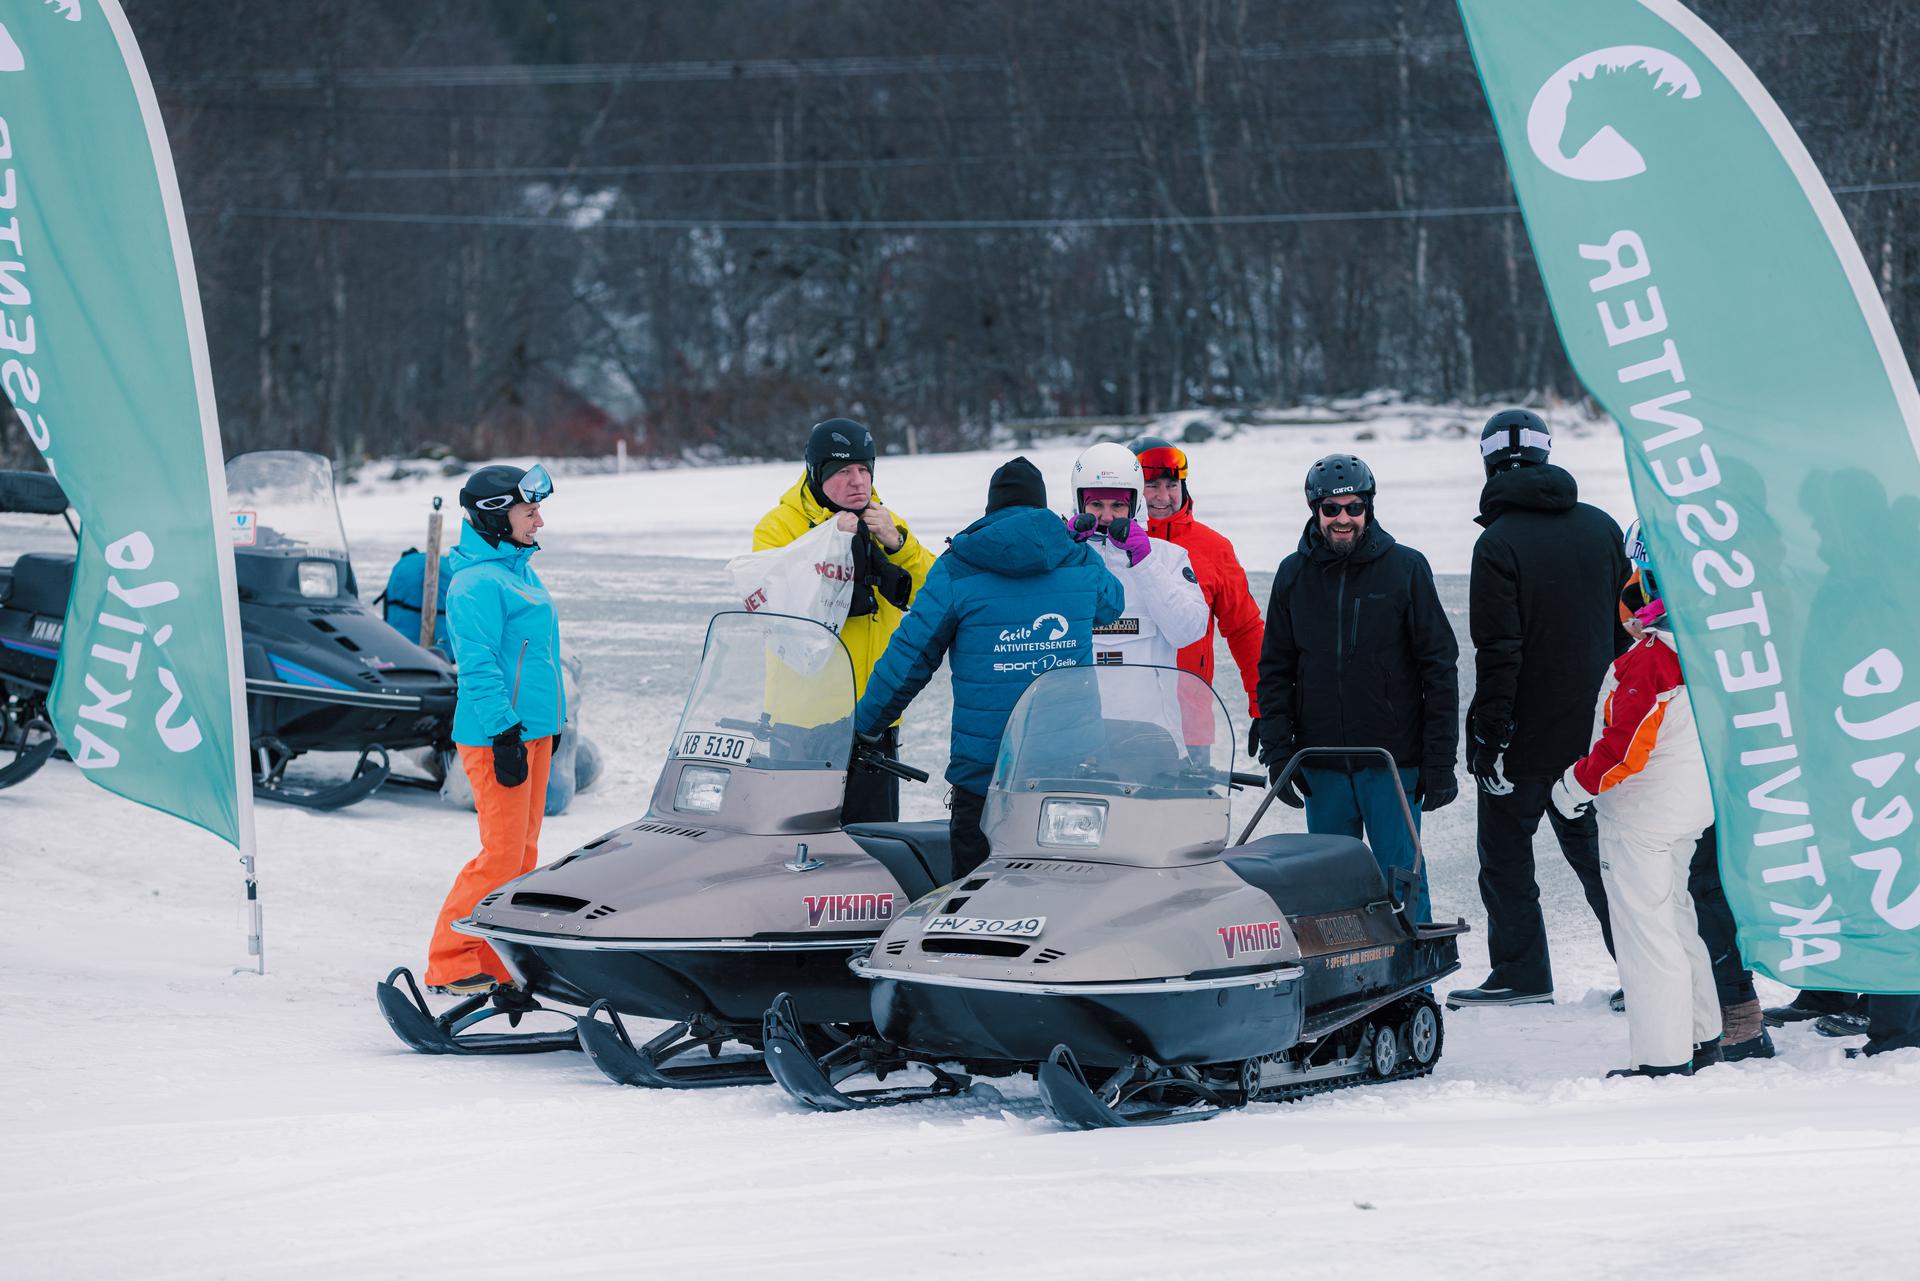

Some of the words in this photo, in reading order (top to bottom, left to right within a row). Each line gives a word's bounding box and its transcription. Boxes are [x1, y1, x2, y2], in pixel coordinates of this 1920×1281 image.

[1332, 486, 1354, 494] GIRO
[32, 620, 63, 643] YAMA
[1000, 627, 1032, 641] Geilo
[993, 640, 1077, 653] AKTIVITETSSENTER
[1056, 658, 1077, 667] Geilo
[682, 734, 701, 755] KB
[704, 735, 745, 760] 5130
[803, 893, 894, 928] VIKING
[969, 919, 1039, 934] 3049
[1217, 921, 1282, 959] VIKING
